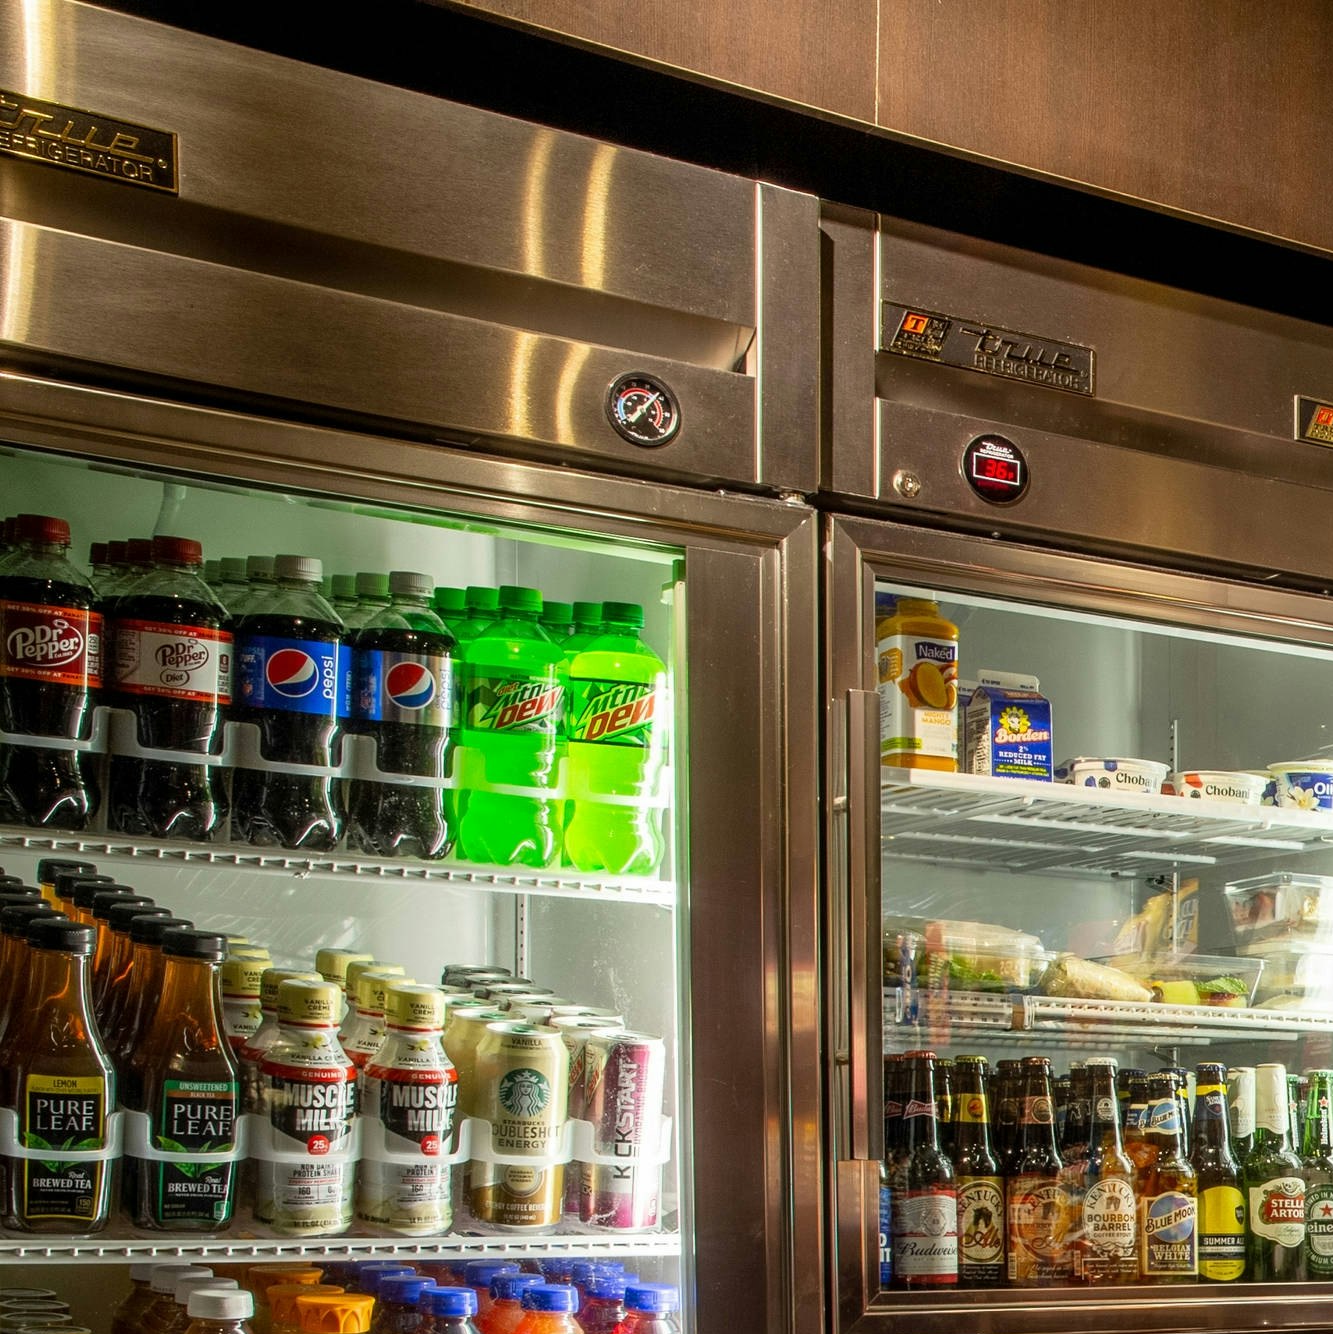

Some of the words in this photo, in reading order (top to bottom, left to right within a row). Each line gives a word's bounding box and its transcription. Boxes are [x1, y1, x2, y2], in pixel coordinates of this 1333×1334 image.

[0, 131, 153, 181] EFRIGERATOR
[974, 354, 1080, 388] REFRIGERATOR
[918, 644, 953, 660] Naked
[321, 655, 336, 699] pepsi
[994, 728, 1049, 744] Borden
[999, 751, 1033, 760] REDUCED
[1014, 758, 1033, 766] MILK
[53, 1079, 77, 1088] LEMON
[179, 1082, 228, 1091] UNSWEETENED
[36, 1099, 94, 1115] PURE
[173, 1103, 233, 1120] PURE
[498, 1140, 546, 1149] ENERGY
[33, 1178, 72, 1189] BREWED
[74, 1179, 92, 1189] TEA
[168, 1183, 210, 1193] BREWED
[1087, 1213, 1134, 1222] BOURBON
[1146, 1215, 1172, 1234] BLUE
[1173, 1206, 1196, 1223] MOON
[1093, 1222, 1132, 1231] BARREL
[1203, 1237, 1229, 1245] SUMMER
[1154, 1252, 1191, 1261] WHITE
